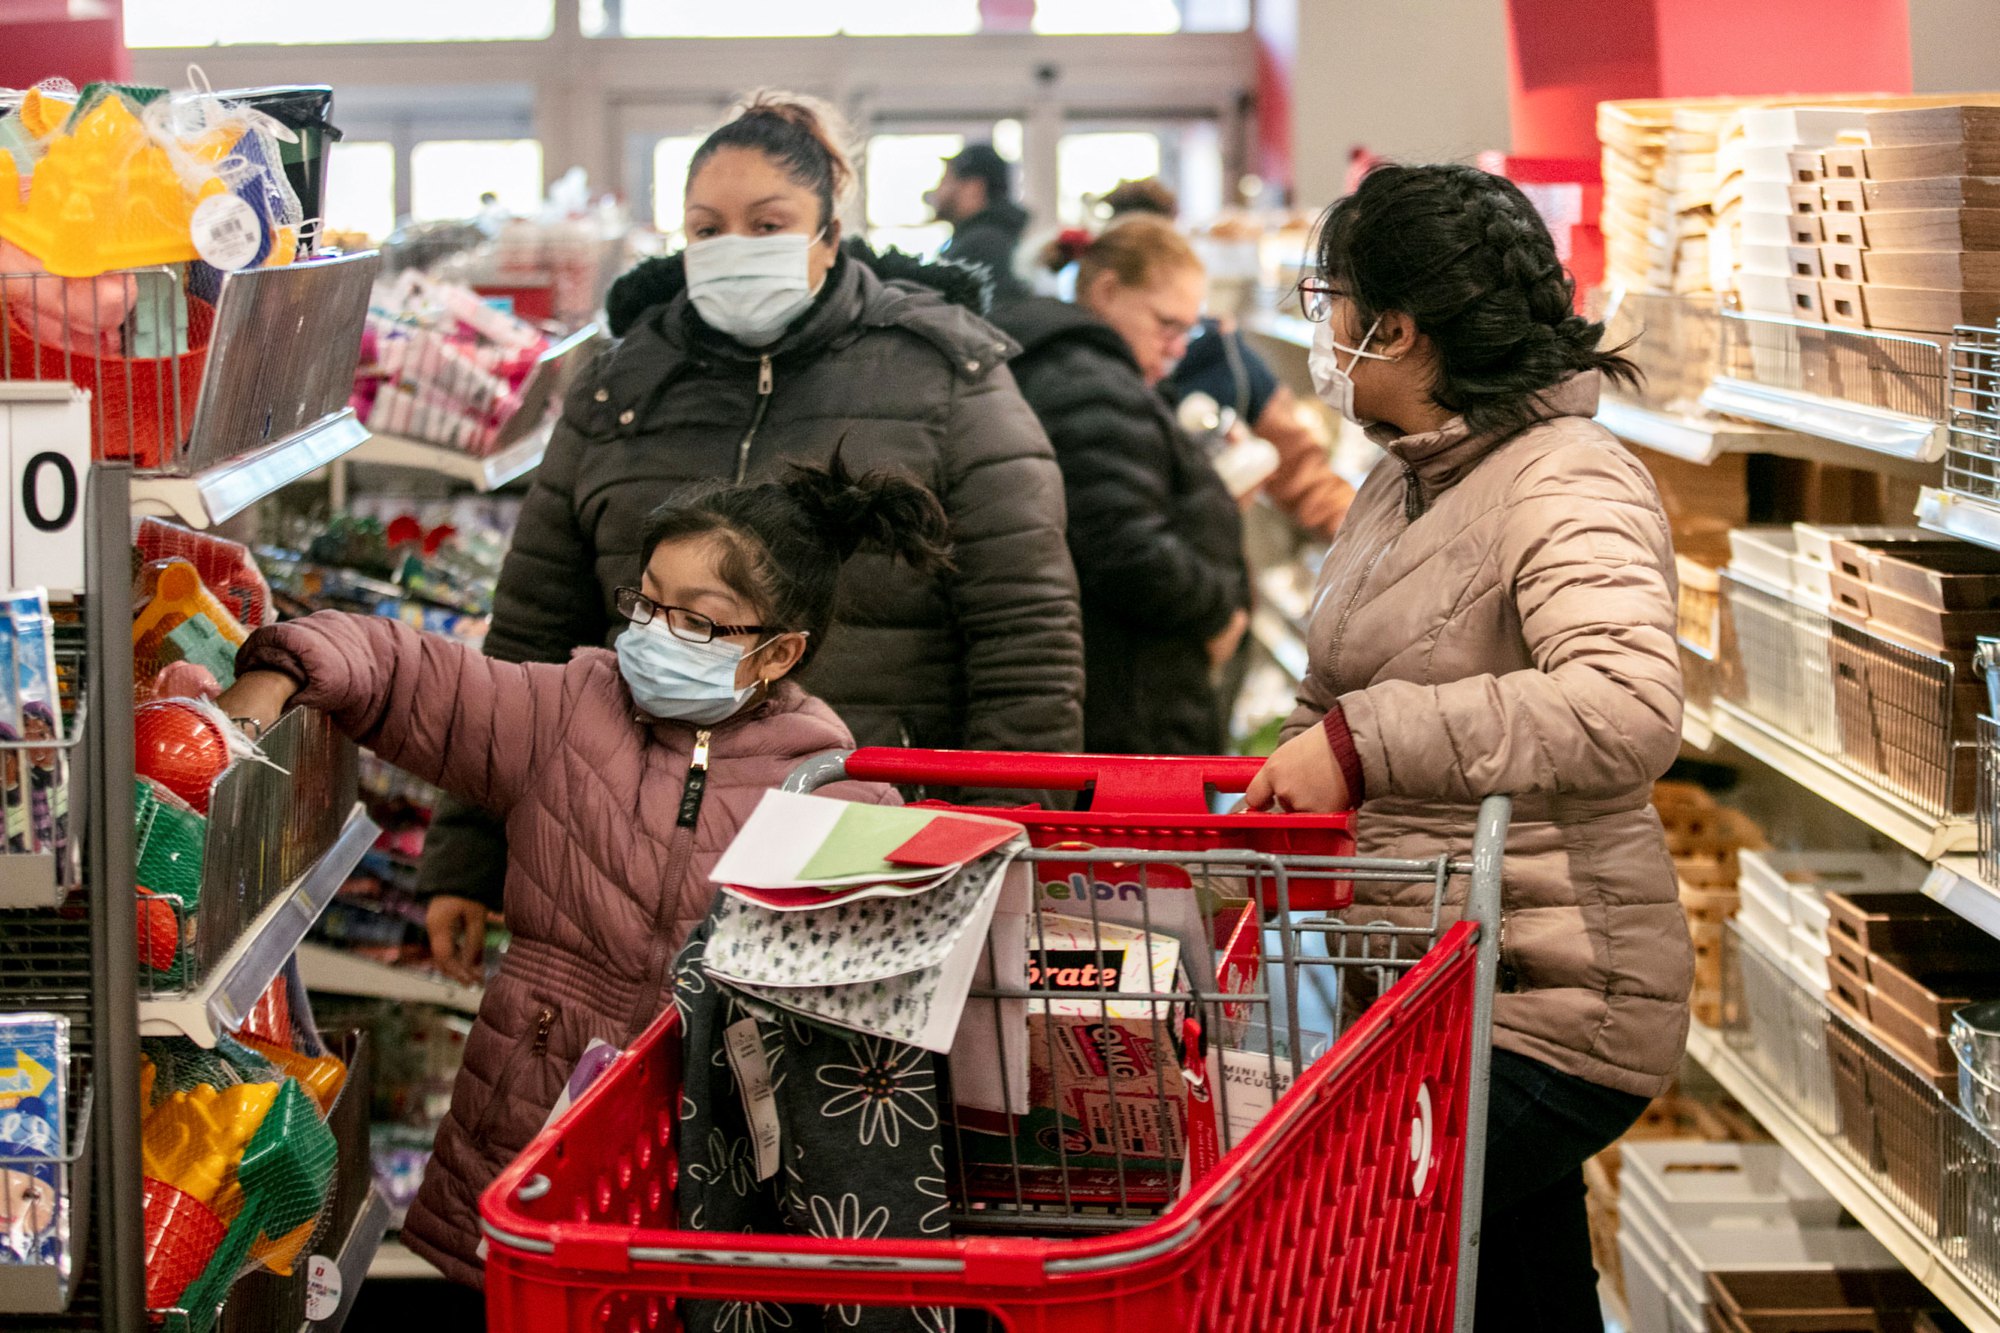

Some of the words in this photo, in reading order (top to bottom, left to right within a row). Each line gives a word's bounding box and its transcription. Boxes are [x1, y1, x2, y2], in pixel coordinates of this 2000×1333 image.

[22, 451, 78, 533] 0
[1039, 873, 1143, 900] elon
[1223, 1064, 1256, 1077] MINI
[1263, 1070, 1290, 1084] USB
[1223, 1073, 1287, 1091] VACUUM
